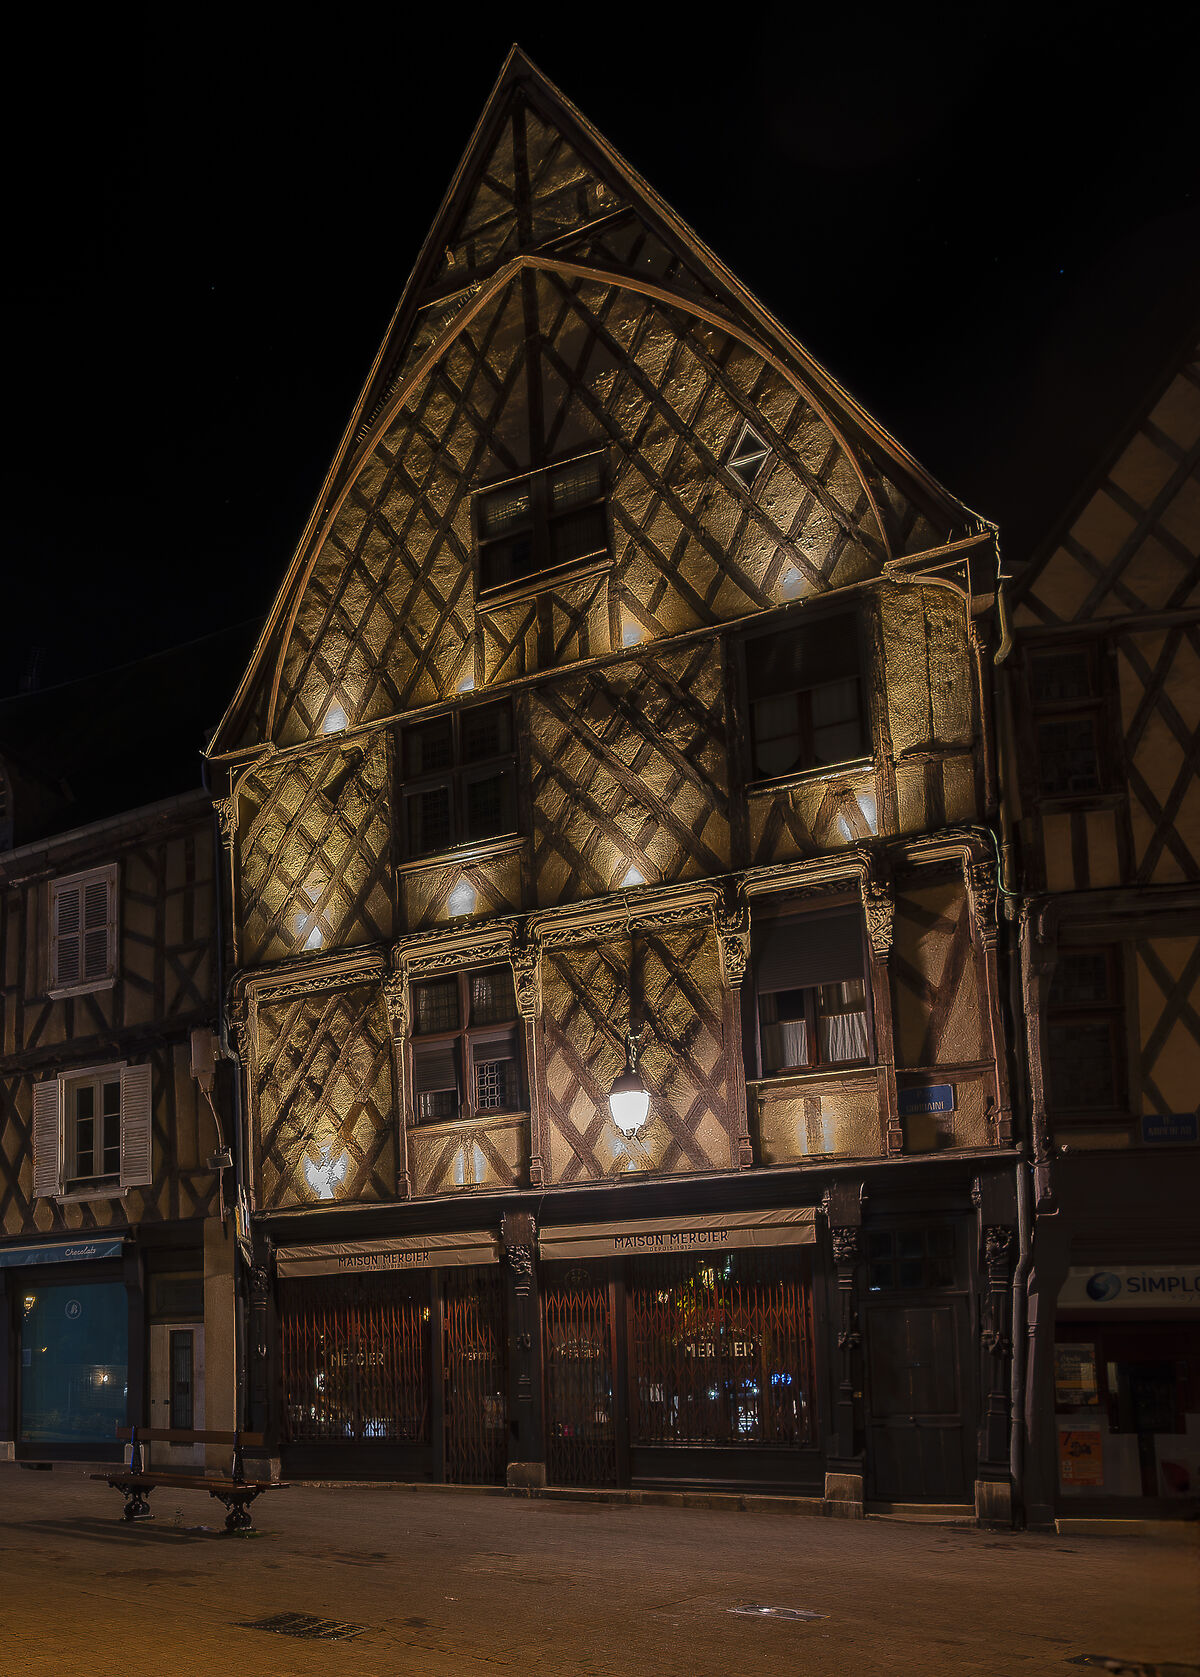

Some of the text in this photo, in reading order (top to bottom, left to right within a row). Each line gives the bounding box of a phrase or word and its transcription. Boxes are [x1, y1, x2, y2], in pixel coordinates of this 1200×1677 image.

[614, 1230, 728, 1248] MAISON MERCIER
[338, 1250, 429, 1267] MAISON MERCIER
